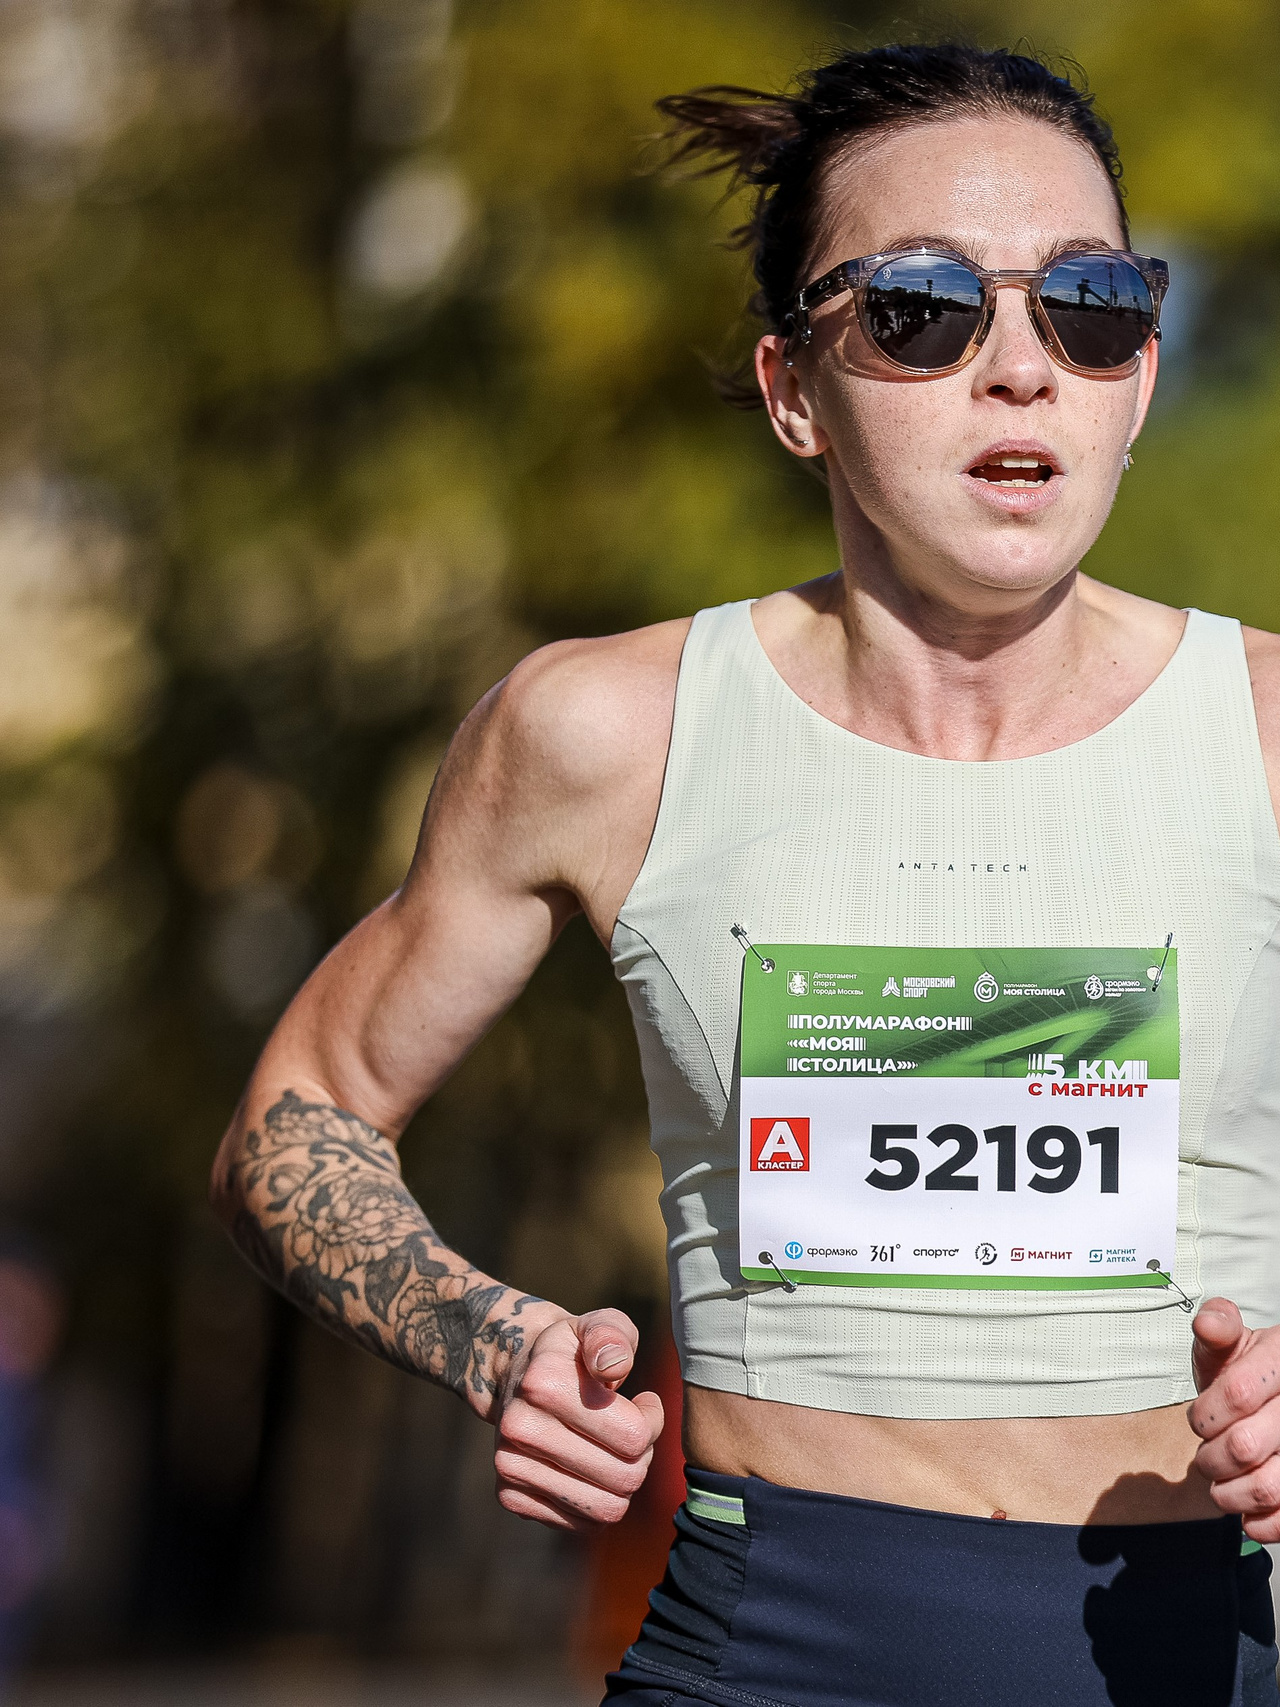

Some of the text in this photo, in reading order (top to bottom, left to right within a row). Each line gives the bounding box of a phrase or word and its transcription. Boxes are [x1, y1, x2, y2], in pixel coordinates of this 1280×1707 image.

[898, 862, 1027, 873] ANTA TECH
[813, 972, 858, 980] Департамент
[903, 976, 956, 988] МОСКОВСКИЙ
[837, 988, 864, 996] Москвы
[903, 988, 928, 998] СПОРТ
[1003, 988, 1066, 997] МОЯ СТОЛИЦА
[799, 1014, 962, 1031] ПОЛУМАРАФОН
[1043, 1053, 1066, 1079] 5
[1028, 1082, 1149, 1098] с магнит
[758, 1121, 805, 1161] А
[864, 1123, 1120, 1194] 52191
[757, 1161, 804, 1170] КЛАСТЕР
[807, 1247, 858, 1258] фармэко
[1028, 1251, 1073, 1260] МАГНИТ
